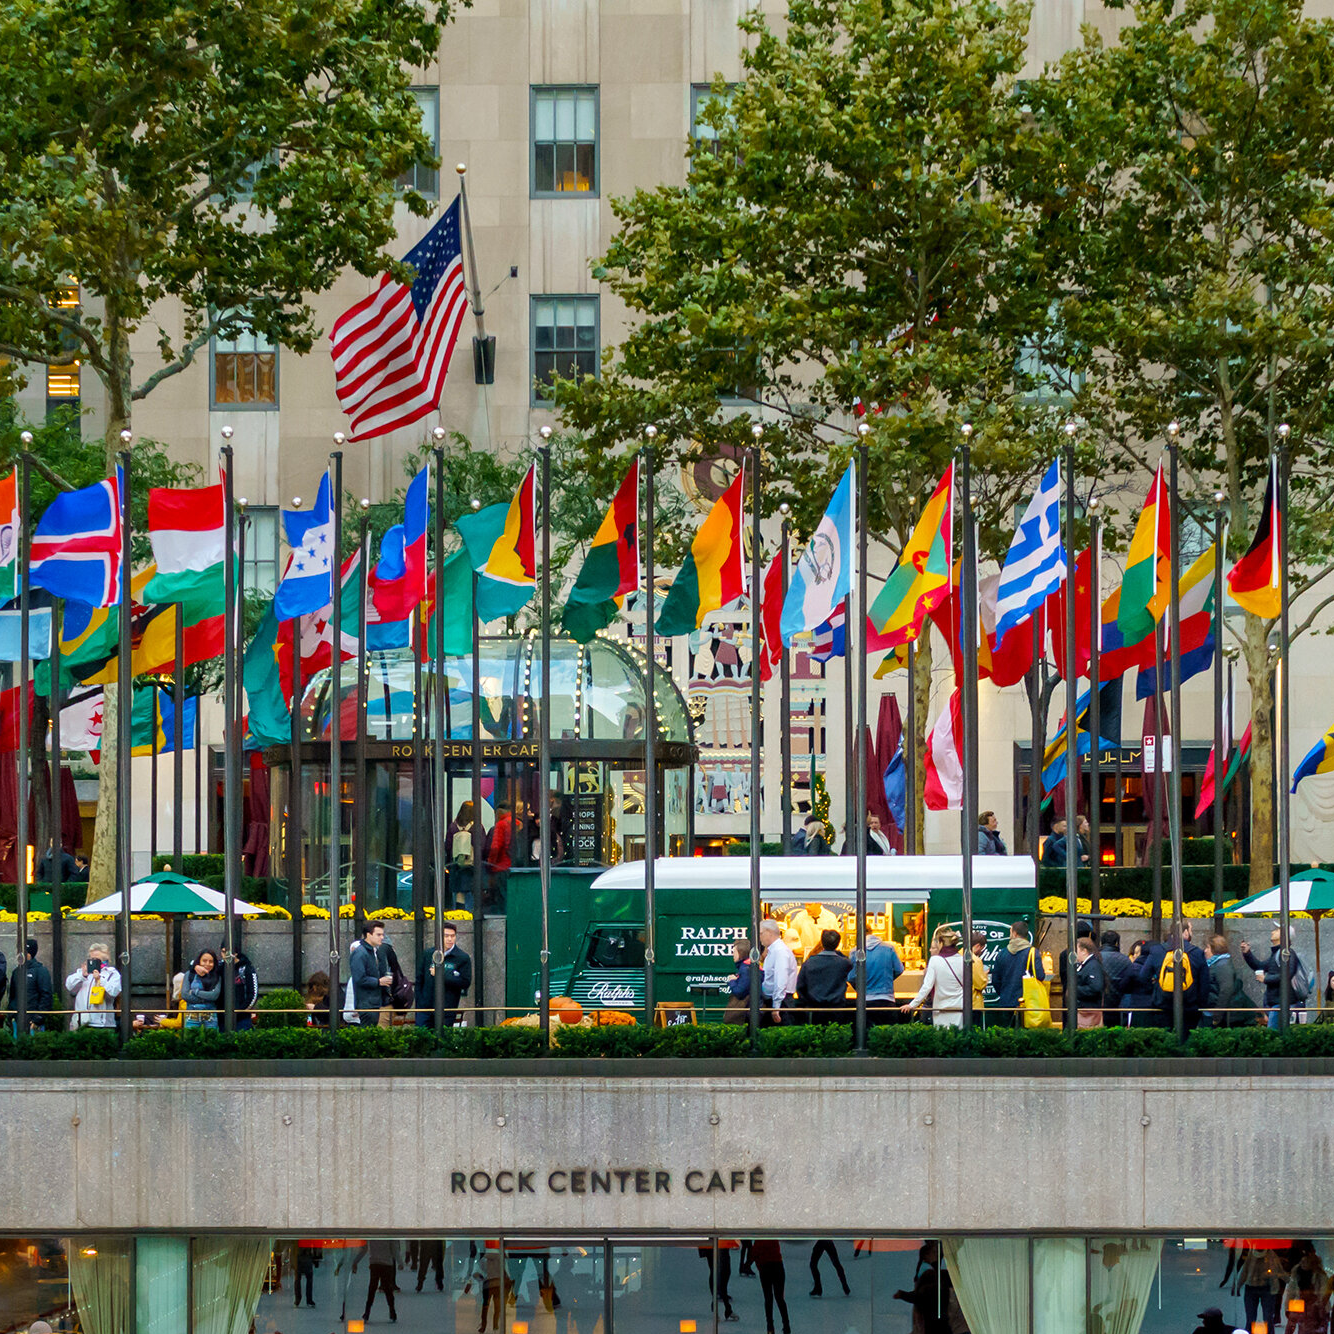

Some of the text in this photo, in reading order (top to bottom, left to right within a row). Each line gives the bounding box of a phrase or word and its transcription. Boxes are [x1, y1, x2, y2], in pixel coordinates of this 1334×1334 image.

[392, 744, 542, 757] ROK CENER CAF
[680, 927, 748, 940] RALPH
[989, 931, 1005, 939] OF
[675, 943, 735, 956] LAURE
[451, 1166, 765, 1193] ROCK CENTER CAFÉ
